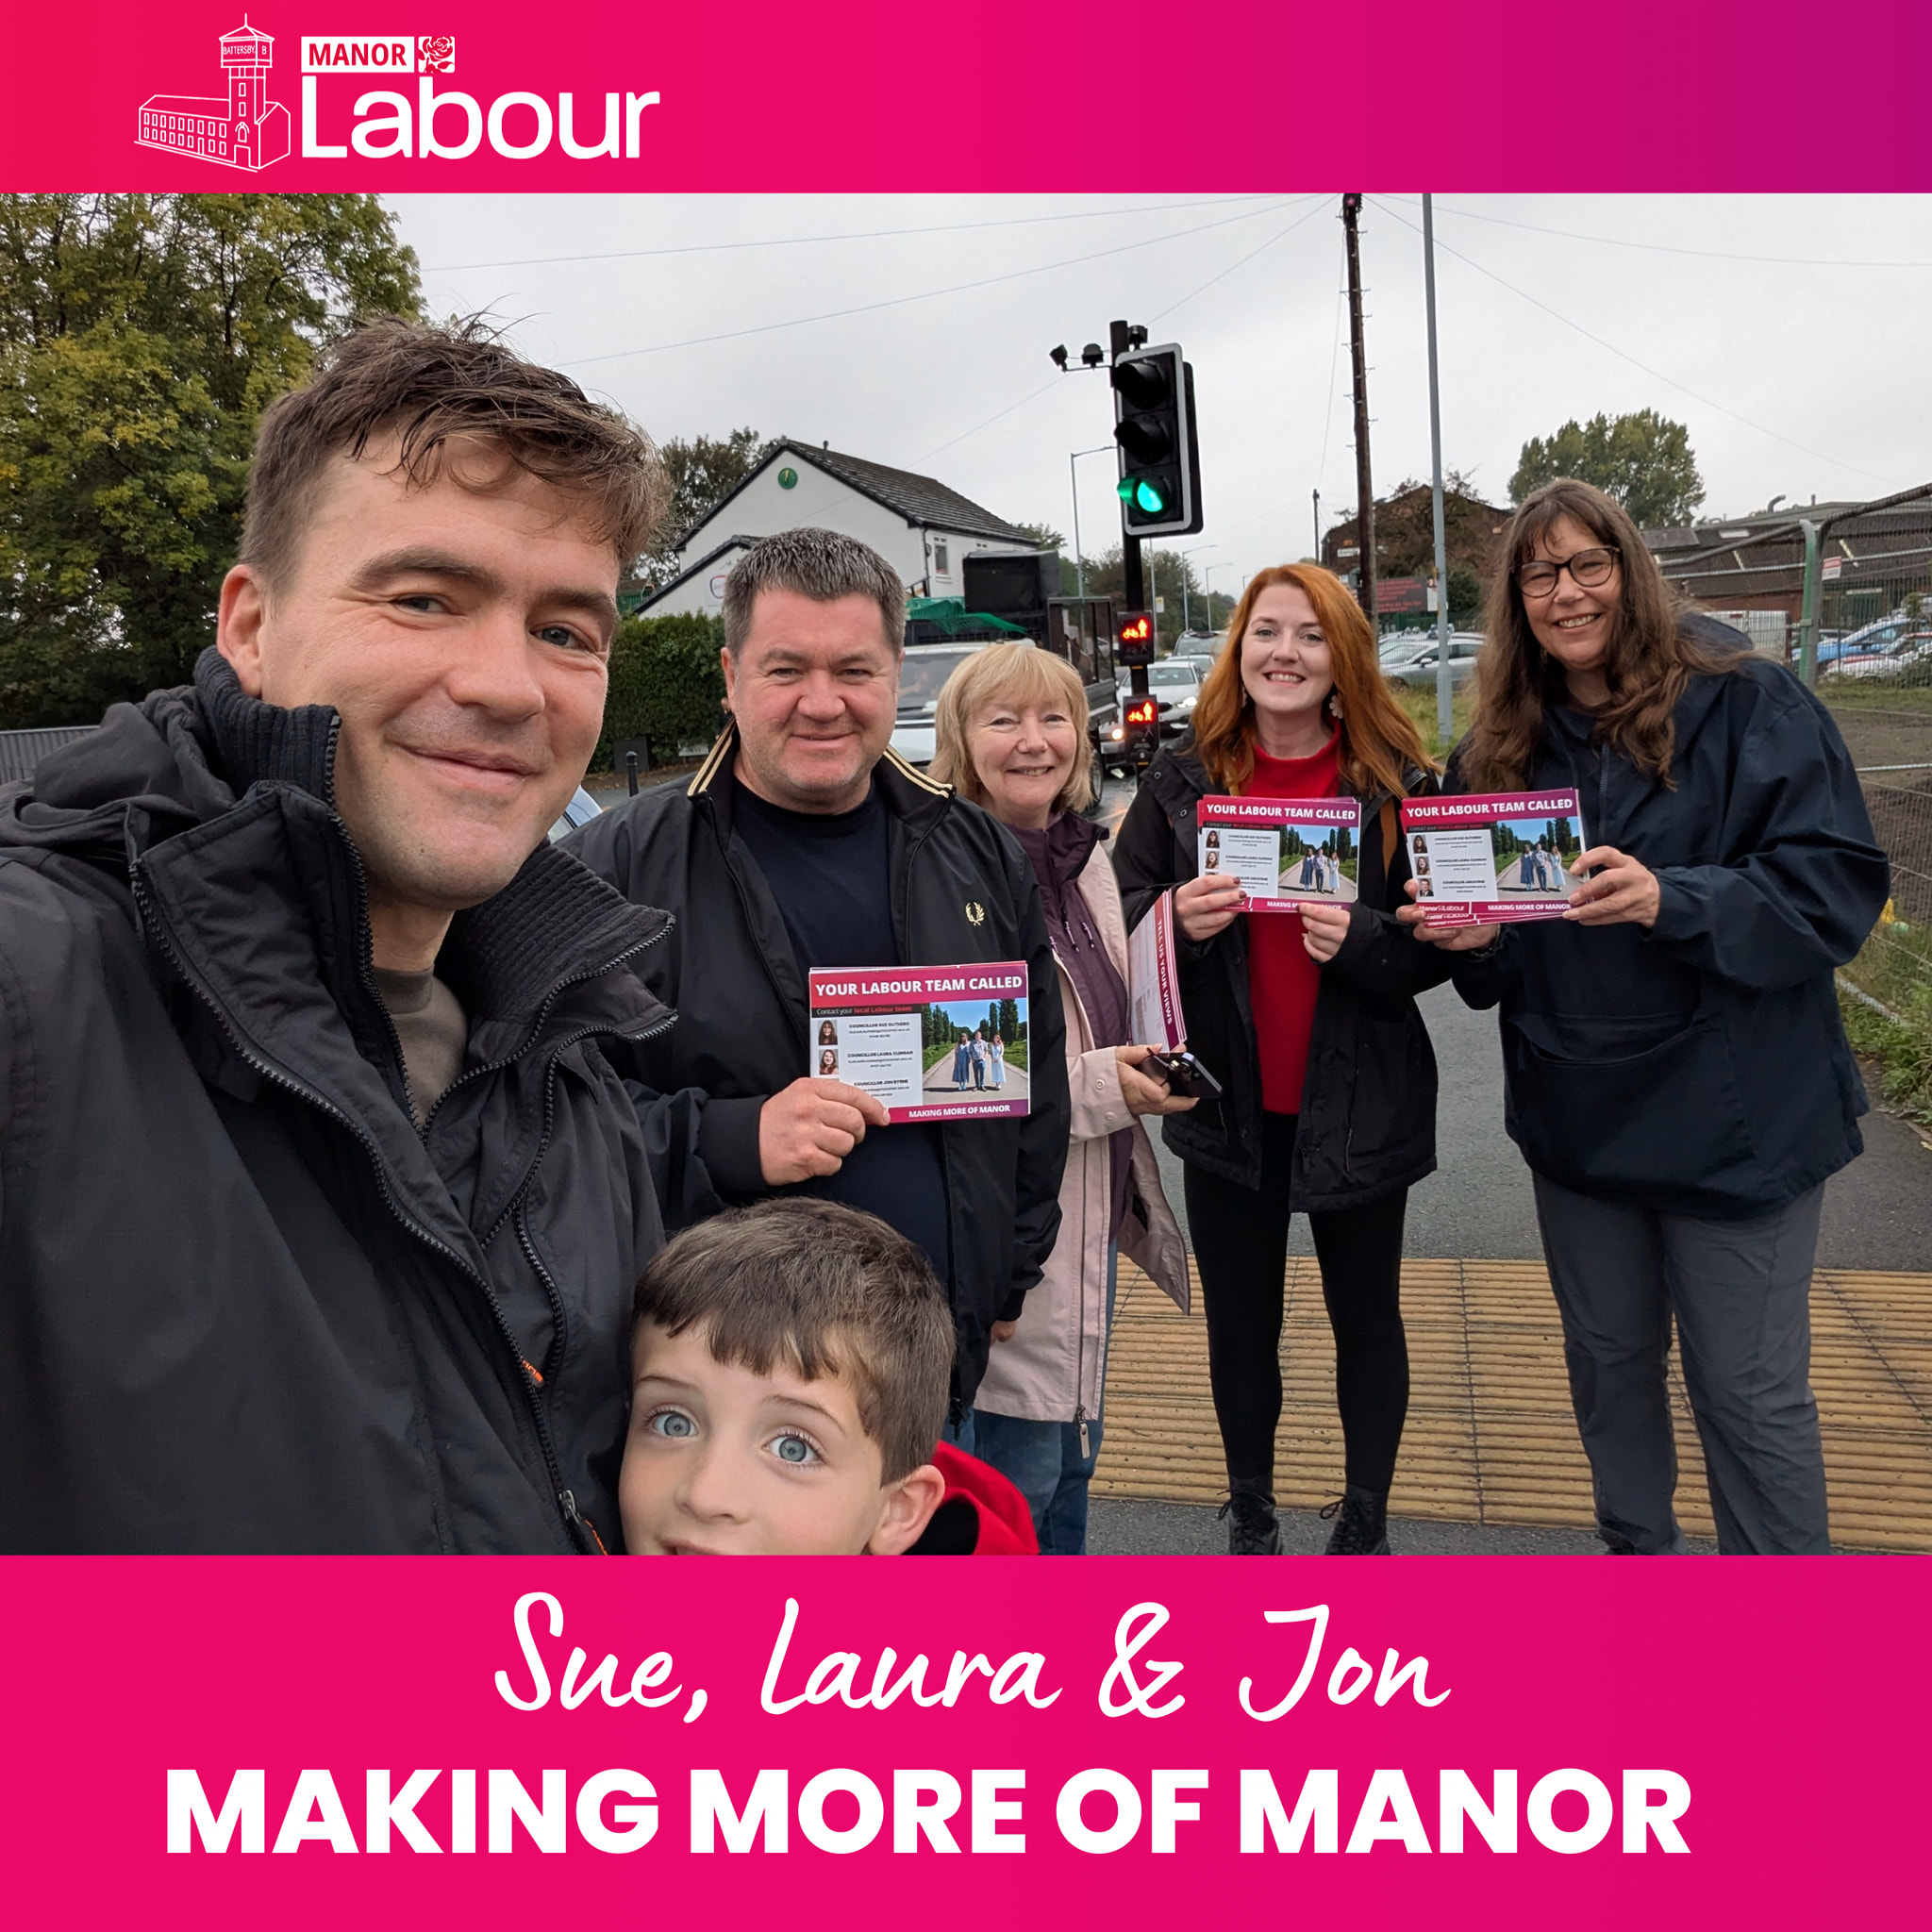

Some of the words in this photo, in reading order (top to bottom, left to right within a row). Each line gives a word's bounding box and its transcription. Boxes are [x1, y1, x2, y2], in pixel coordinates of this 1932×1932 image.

[1207, 804, 1237, 815] YOUR
[1239, 806, 1282, 817] LABOUR
[1284, 807, 1313, 818] TEAM
[1315, 808, 1356, 821] CALLED
[1407, 807, 1440, 818] YOUR
[1441, 804, 1490, 816] LABOUR
[1491, 802, 1524, 813] TEAM
[1527, 798, 1573, 811] CALLED
[1158, 944, 1165, 958] US
[1159, 958, 1168, 988] YOUR
[815, 982, 858, 997] YOUR
[861, 979, 923, 995] LABOUR
[925, 977, 965, 992] TEAM
[969, 975, 1024, 991] CALLED
[1162, 992, 1173, 1024] VIEWS
[908, 1108, 941, 1118] MAKING
[943, 1107, 967, 1116] MORE
[967, 1106, 978, 1114] OF
[979, 1105, 1010, 1113] MANOR
